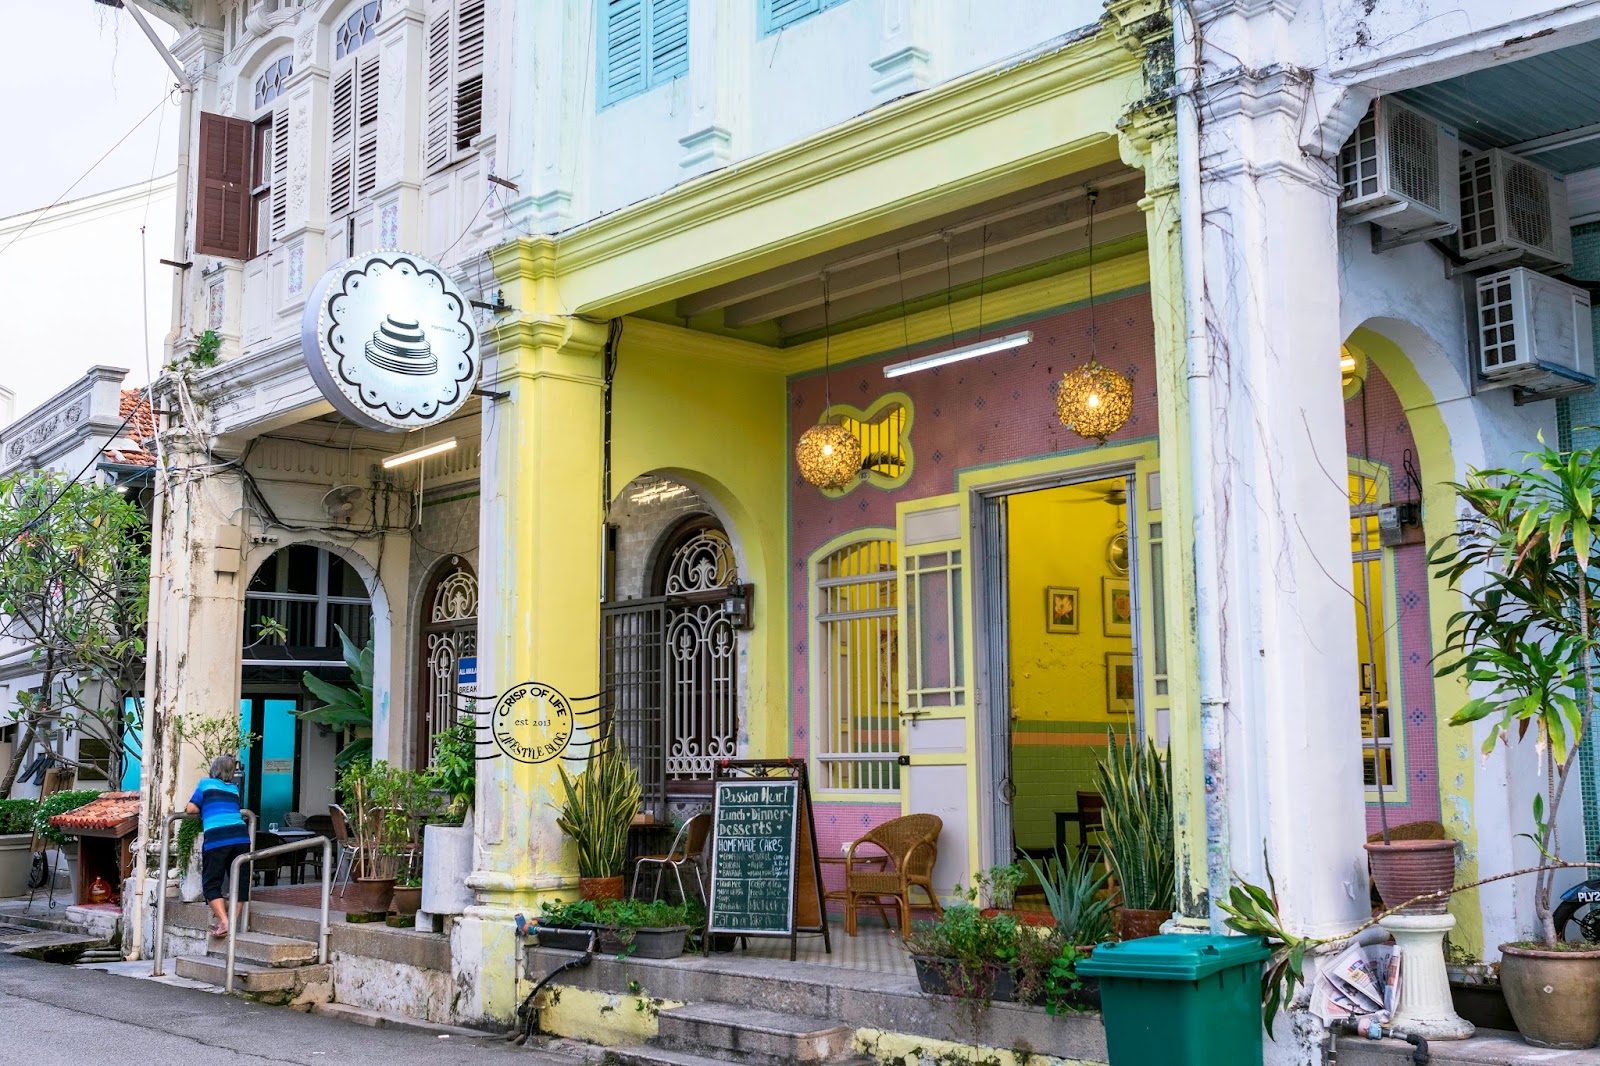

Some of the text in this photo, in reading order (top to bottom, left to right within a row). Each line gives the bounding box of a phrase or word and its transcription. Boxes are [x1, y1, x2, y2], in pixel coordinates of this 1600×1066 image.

[721, 786, 788, 805] Passion Heart
[719, 808, 788, 821] Lunch Dinner
[718, 838, 756, 853] HOMEMADE
